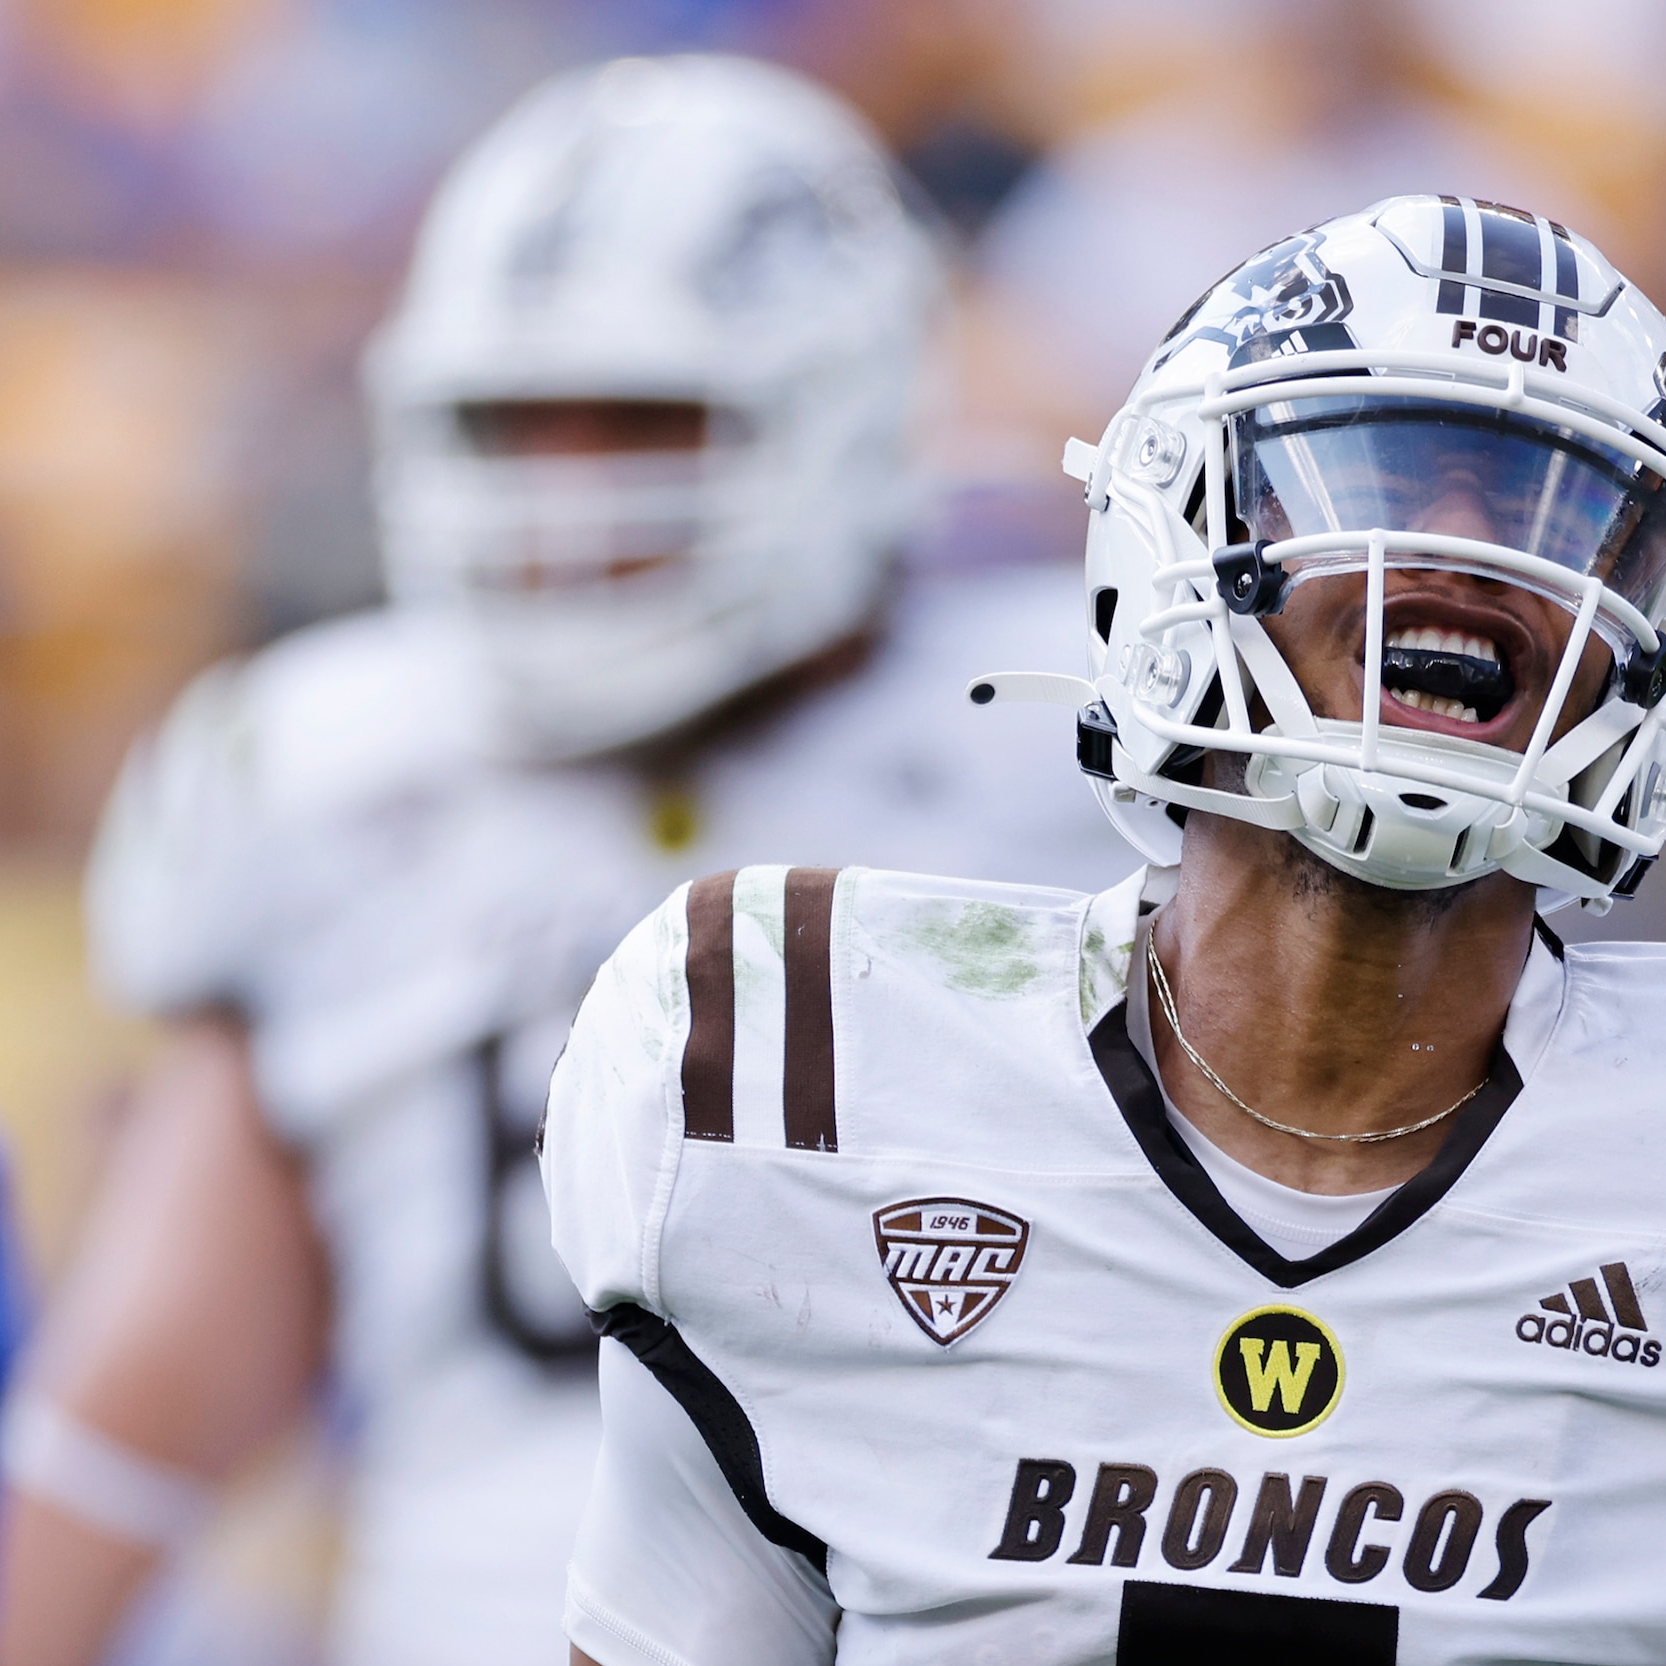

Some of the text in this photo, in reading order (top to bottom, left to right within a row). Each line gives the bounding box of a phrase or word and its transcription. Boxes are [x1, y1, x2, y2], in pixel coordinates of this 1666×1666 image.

[1451, 319, 1568, 373] FOUR
[930, 1215, 971, 1231] 1946
[884, 1241, 1017, 1283] MAC
[1515, 1313, 1663, 1368] adidas
[1239, 1337, 1321, 1415] W
[987, 1457, 1553, 1602] BRONCOS
